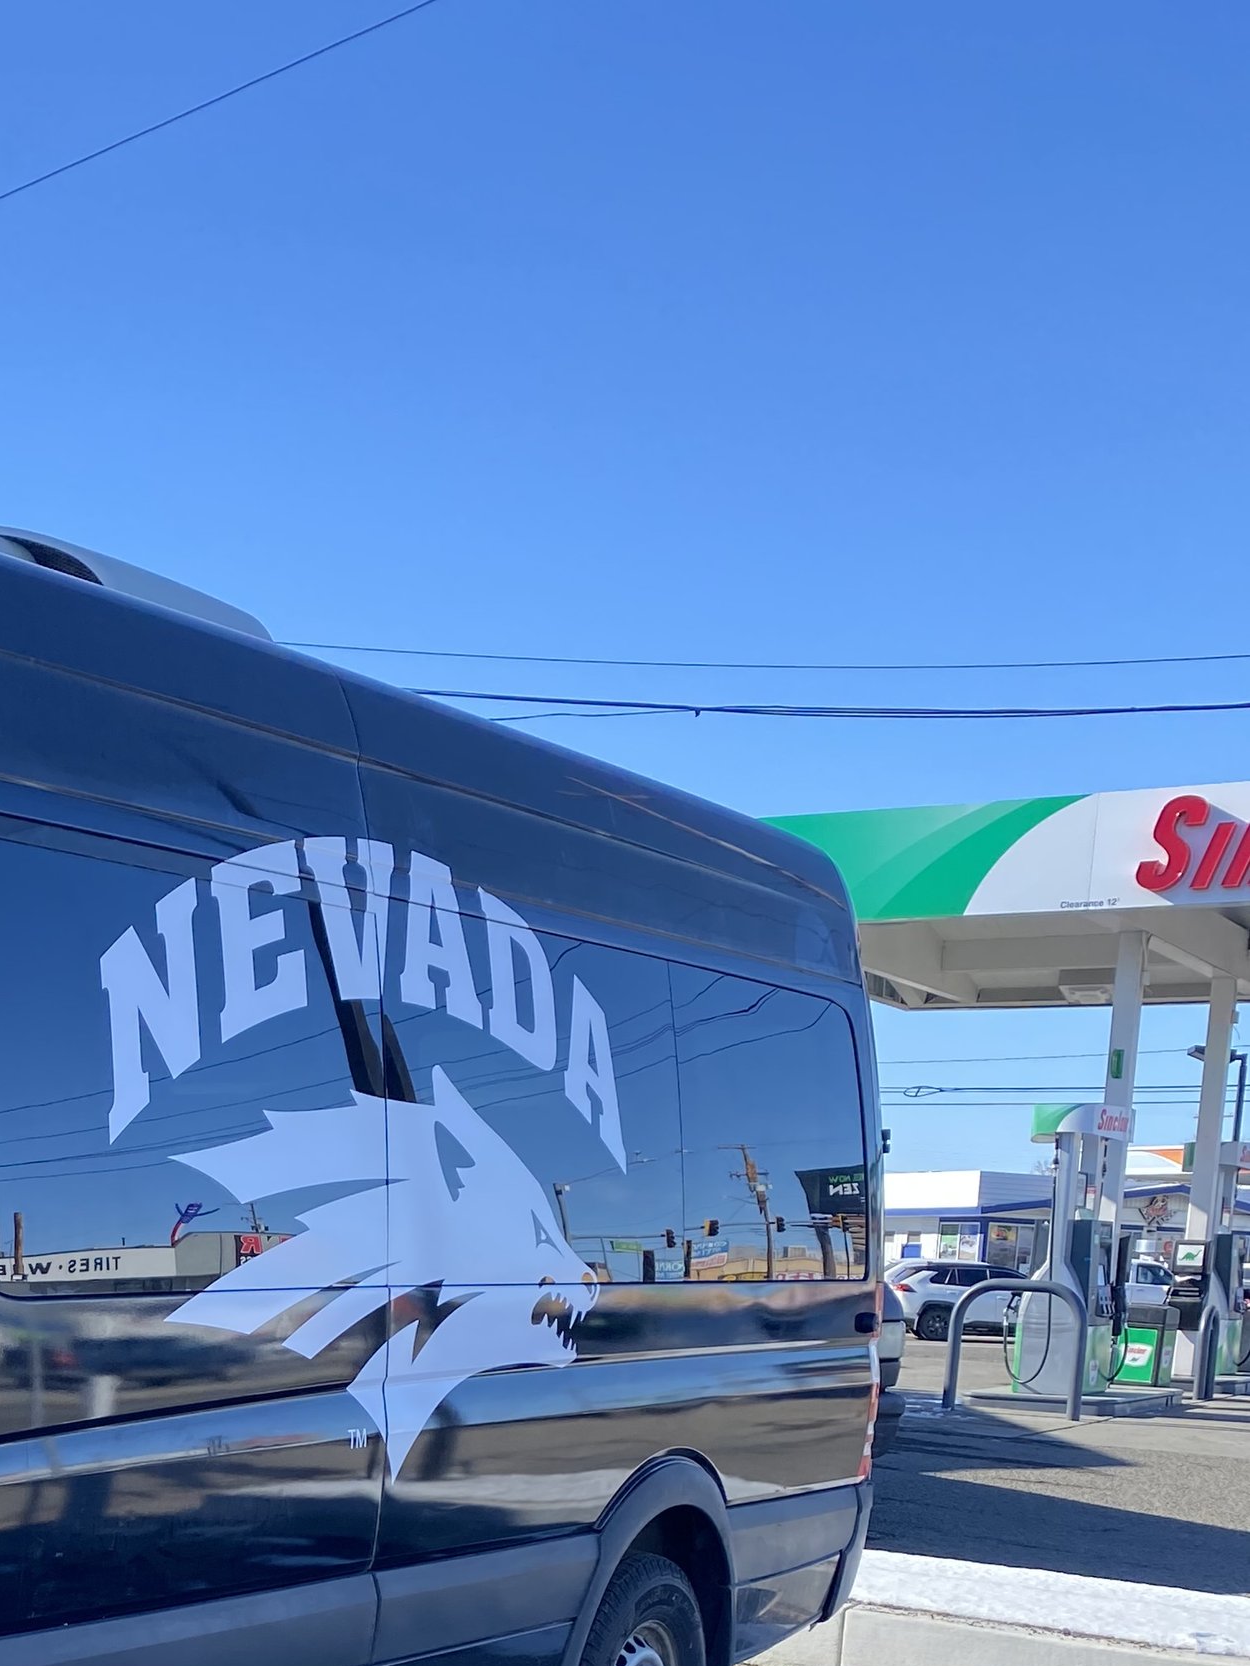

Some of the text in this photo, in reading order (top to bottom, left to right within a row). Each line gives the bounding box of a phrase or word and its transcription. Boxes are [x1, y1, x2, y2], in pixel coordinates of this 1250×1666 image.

[1060, 900, 1104, 909] Clearance
[100, 836, 627, 1174] NEVADA
[348, 1428, 367, 1450] TM
